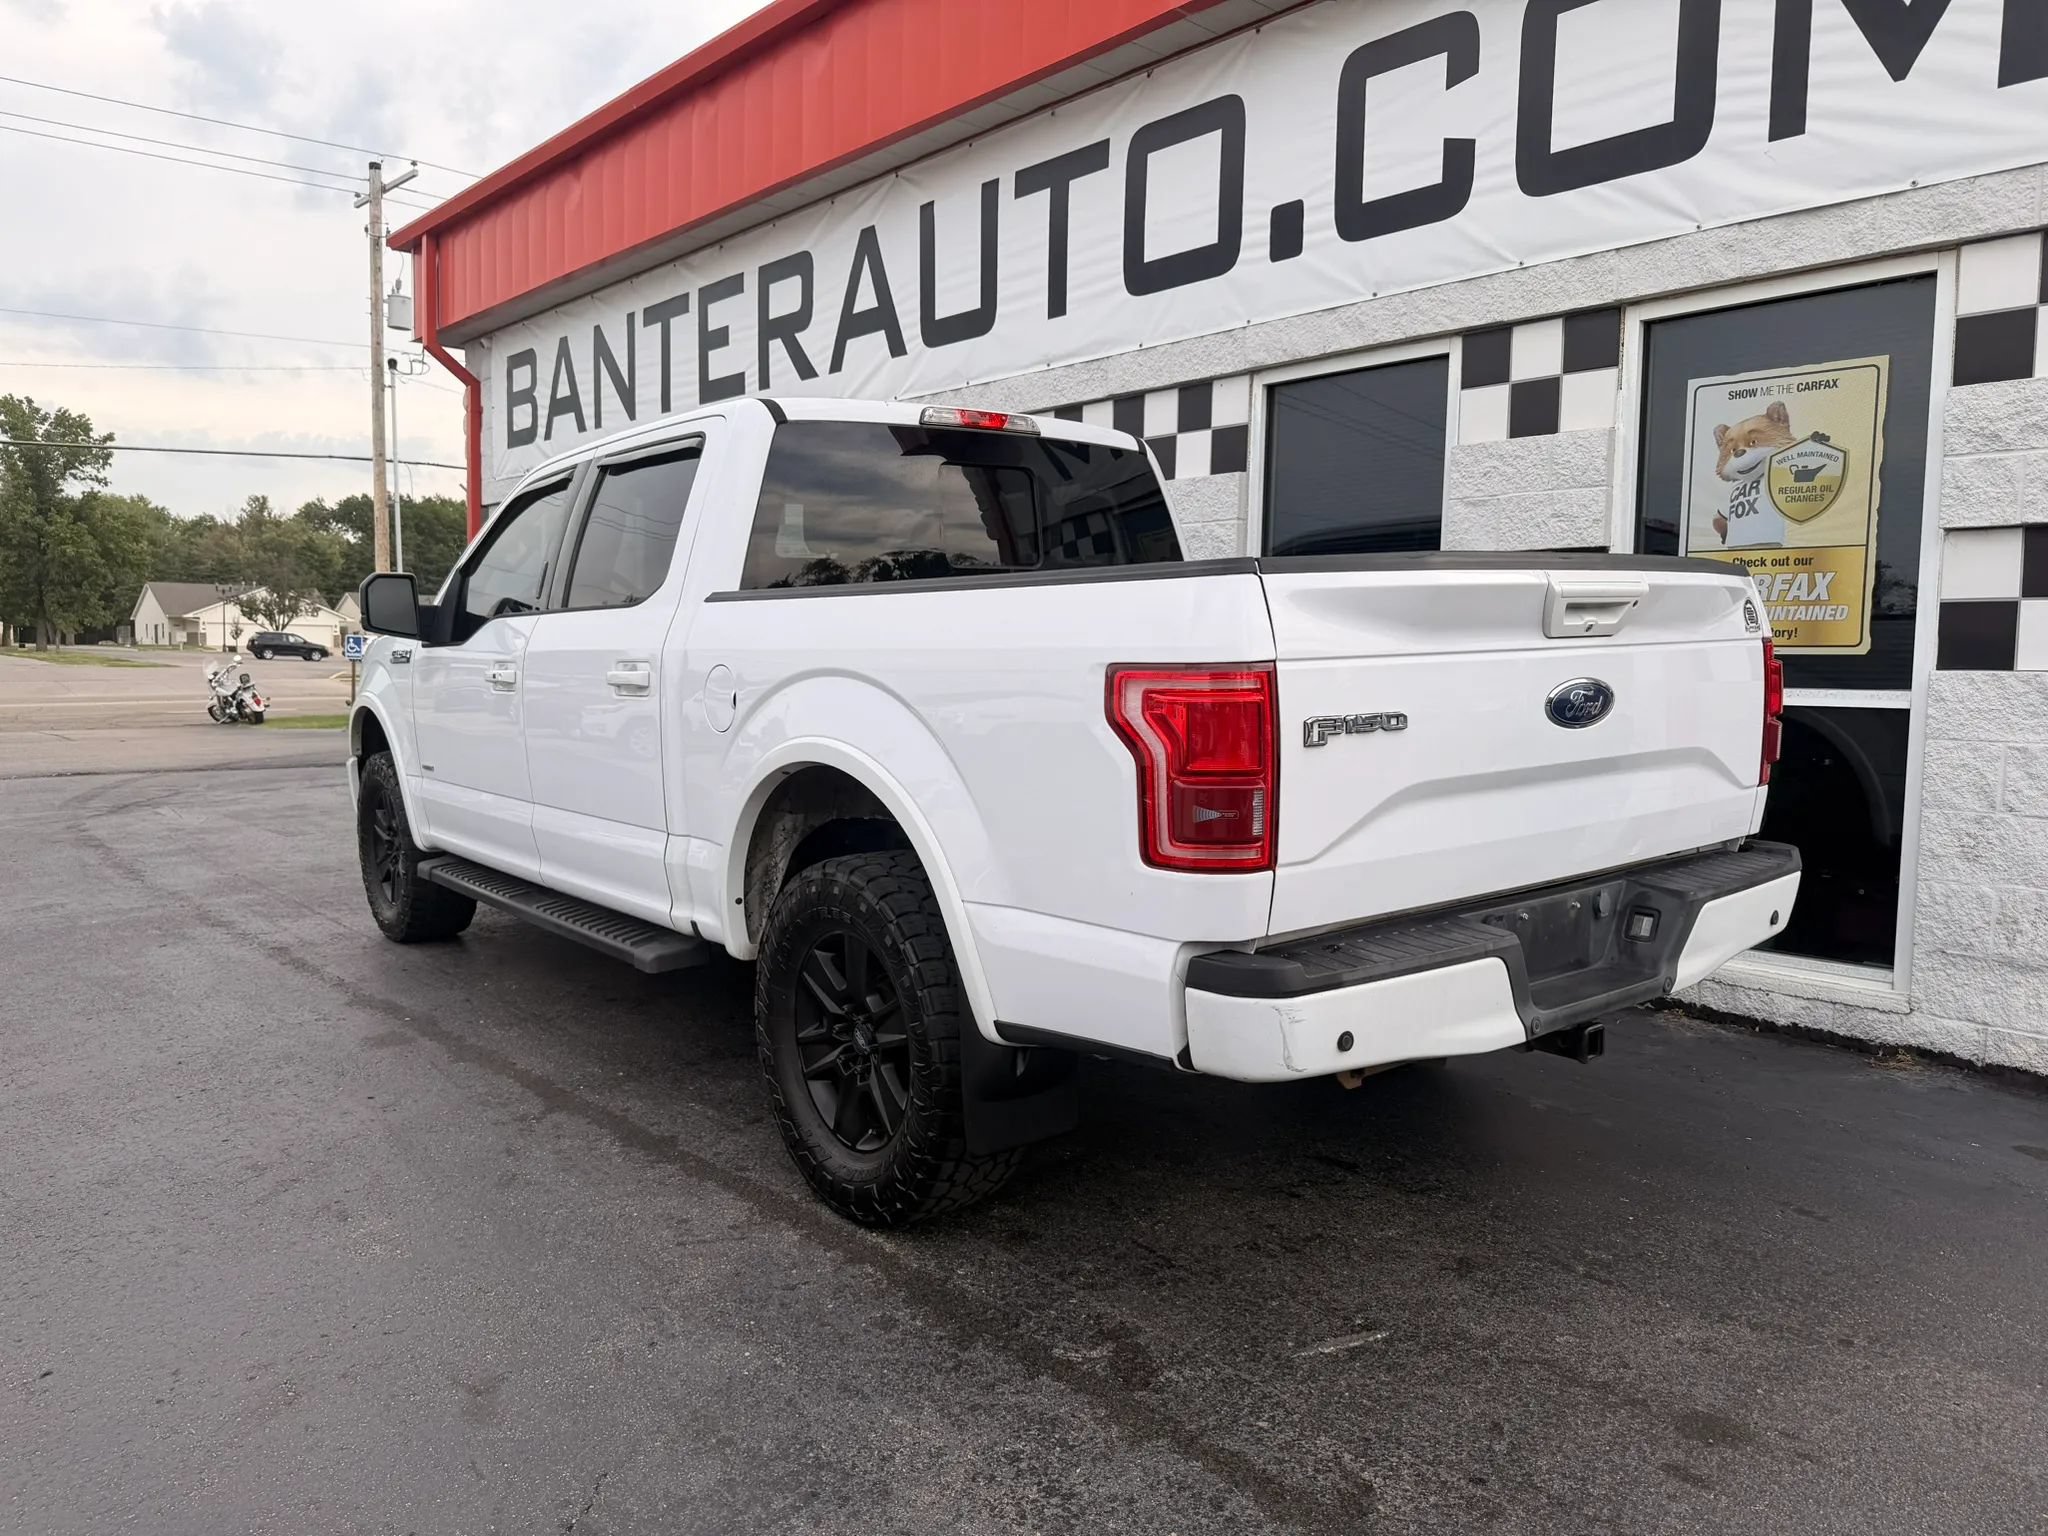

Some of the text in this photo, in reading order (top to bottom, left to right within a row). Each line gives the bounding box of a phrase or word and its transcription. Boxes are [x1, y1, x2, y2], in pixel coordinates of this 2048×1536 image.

[1728, 378, 1839, 400] SHOW ME THE CARFAX
[1776, 451, 1839, 465] WELL MAINTAINED
[1730, 480, 1760, 503] CAR
[1778, 484, 1834, 495] REGULAR OIL
[1785, 494, 1825, 504] CHANGES
[1729, 497, 1759, 522] FOX
[1733, 556, 1814, 568] Check out our
[1753, 572, 1836, 602] RFAX
[1765, 604, 1849, 621] INTAINED
[1565, 688, 1603, 718] Ford
